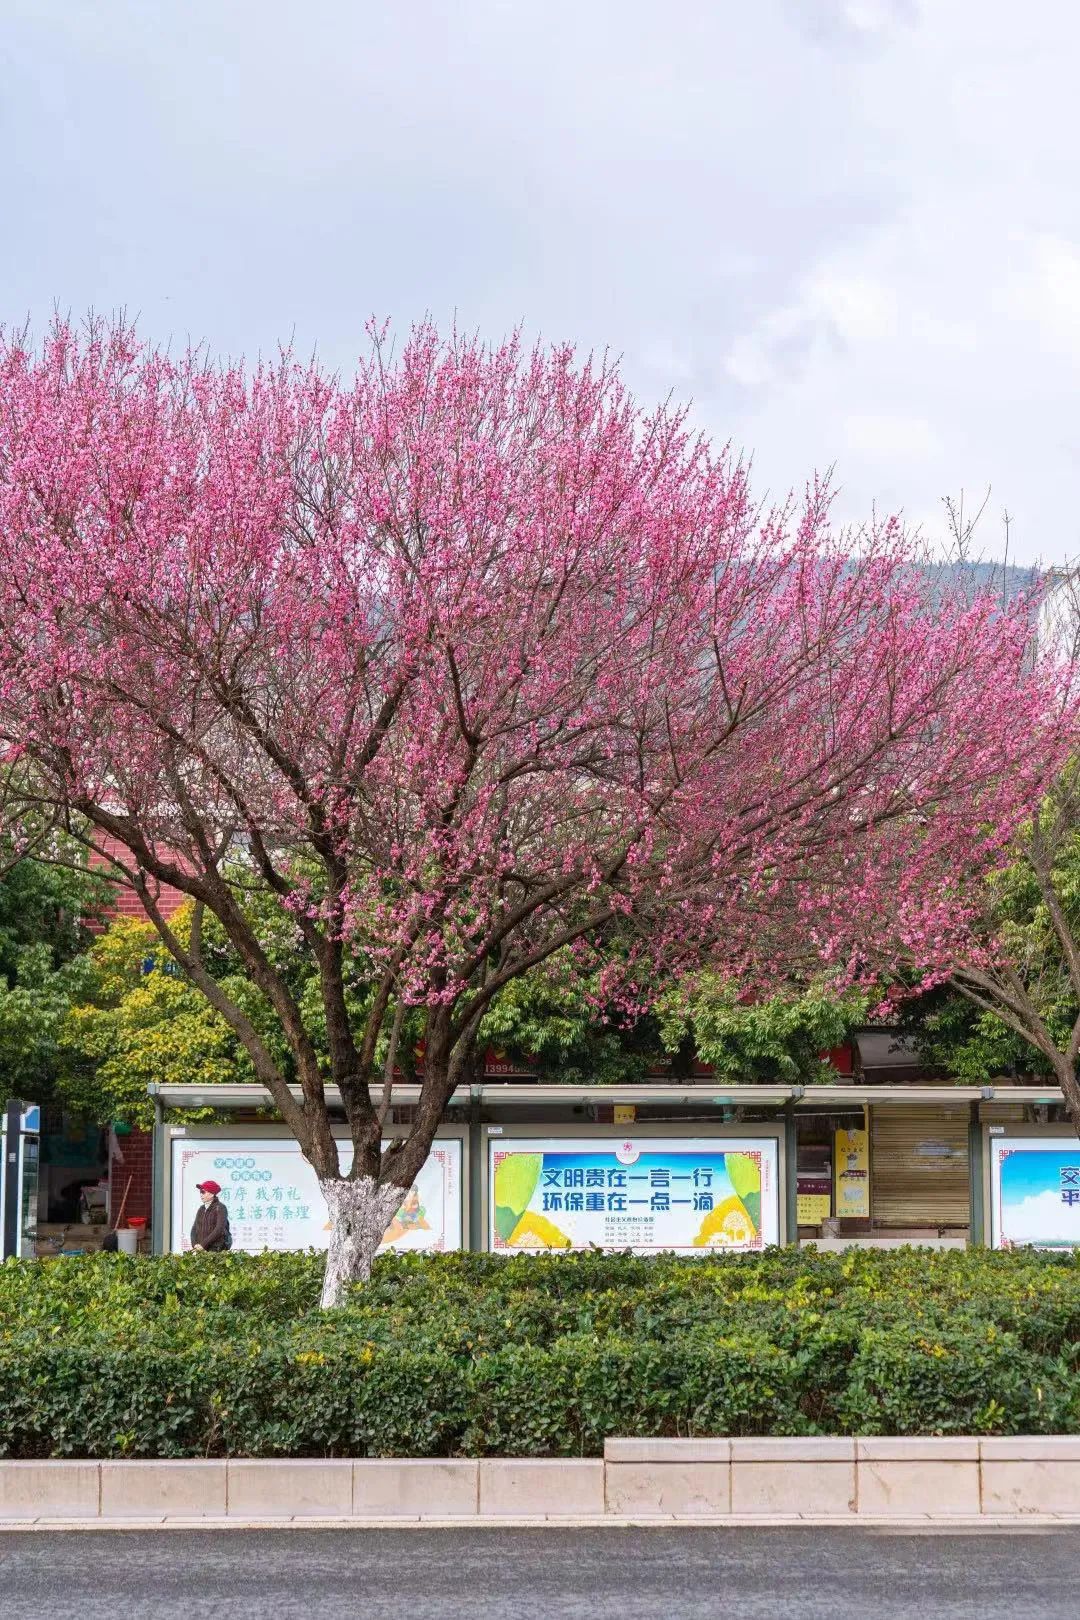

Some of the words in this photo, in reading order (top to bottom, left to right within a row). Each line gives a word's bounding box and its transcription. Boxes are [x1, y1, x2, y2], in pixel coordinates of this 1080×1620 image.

[542, 1168, 714, 1188] 文明贵在一言一行
[255, 1186, 301, 1202] 我有礼
[542, 1192, 714, 1211] 环保重在一点一滴
[228, 1205, 310, 1220] 生活有条理
